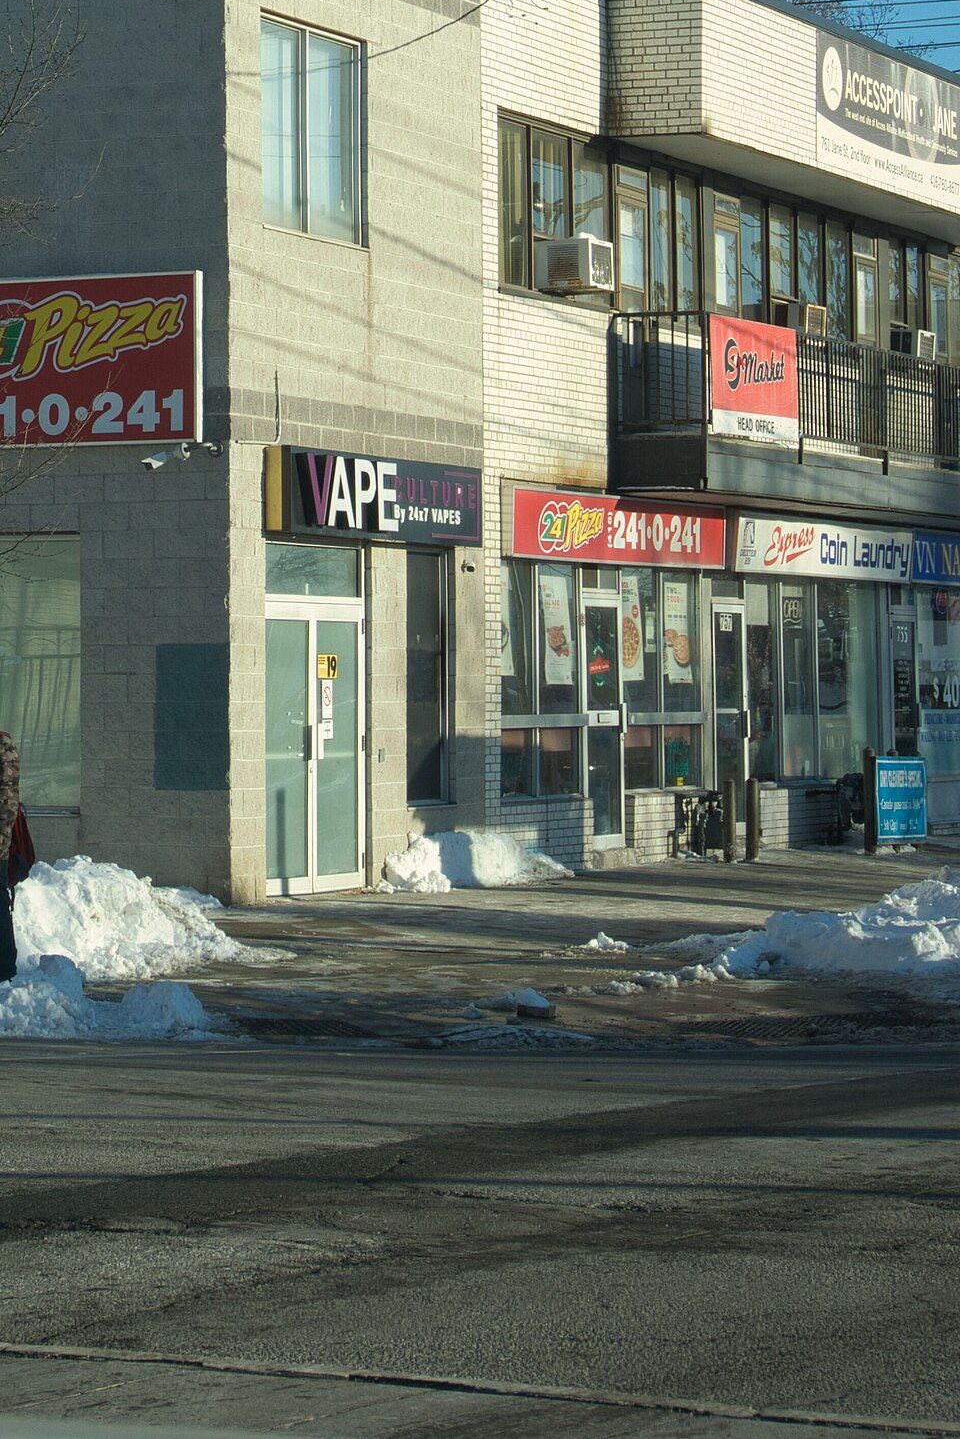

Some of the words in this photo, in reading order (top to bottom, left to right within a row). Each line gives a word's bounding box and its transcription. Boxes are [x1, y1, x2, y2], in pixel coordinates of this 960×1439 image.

[844, 69, 918, 125] ACCESSPOINT
[932, 103, 958, 141] JANE
[13, 292, 187, 380] Pizza
[741, 350, 785, 386] Market
[737, 416, 754, 432] HEAD
[756, 419, 775, 435] OFFICE
[306, 452, 400, 532] VAPE
[393, 476, 476, 510] CULTURE
[394, 504, 406, 524] By
[408, 505, 428, 522] 24x7
[431, 508, 462, 526] VAPES
[565, 501, 604, 552] Pizza
[763, 525, 817, 567] Express
[820, 533, 848, 567] Coin
[853, 535, 911, 578] Laundry
[915, 540, 937, 574] VN
[720, 614, 732, 631] 757
[783, 599, 803, 619] OPEN
[896, 625, 908, 643] 755
[327, 655, 338, 678] 19
